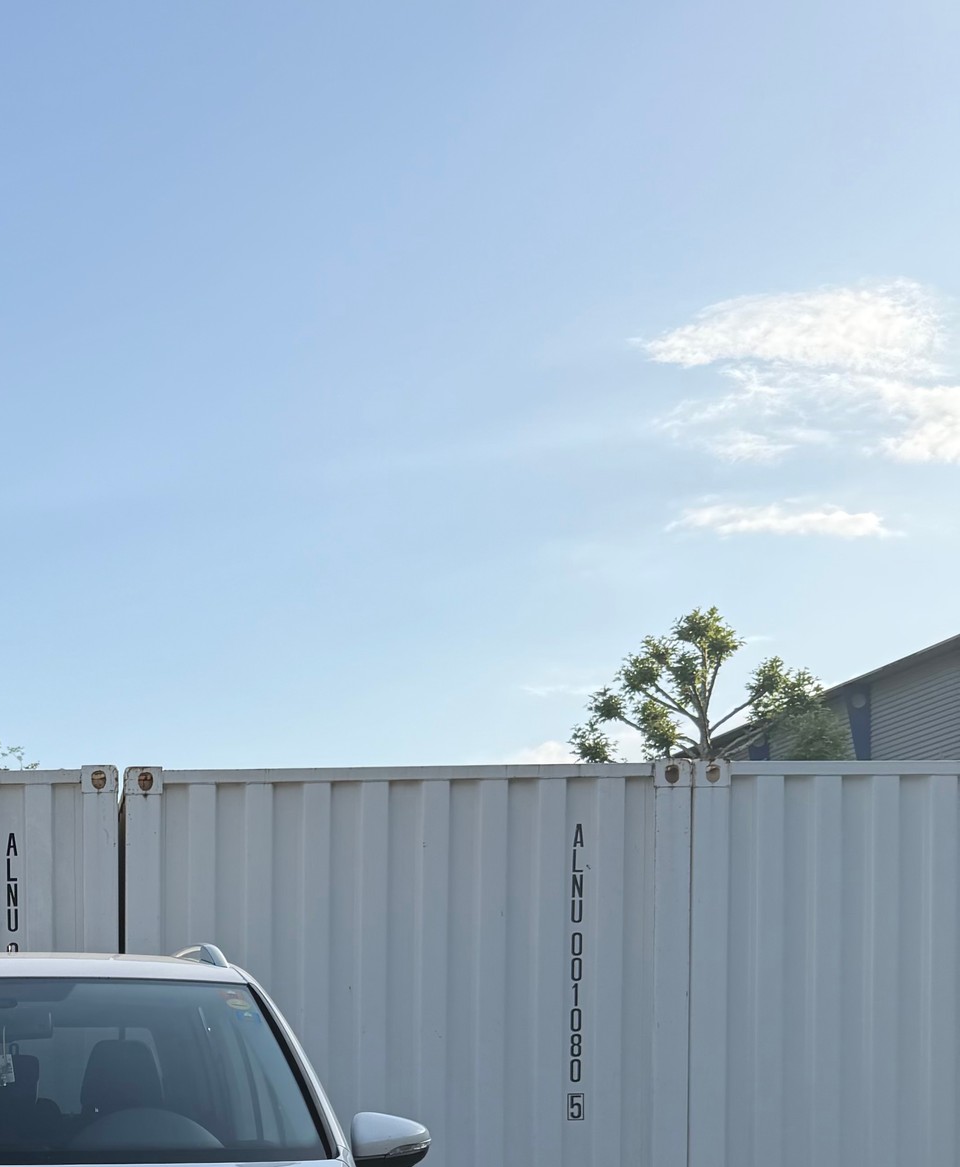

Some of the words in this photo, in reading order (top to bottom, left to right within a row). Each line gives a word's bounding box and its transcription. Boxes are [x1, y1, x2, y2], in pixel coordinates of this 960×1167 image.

[6, 832, 19, 932] ALNU
[571, 823, 585, 923] ALNU
[570, 932, 583, 1083] 001080
[570, 1095, 583, 1119] 5
